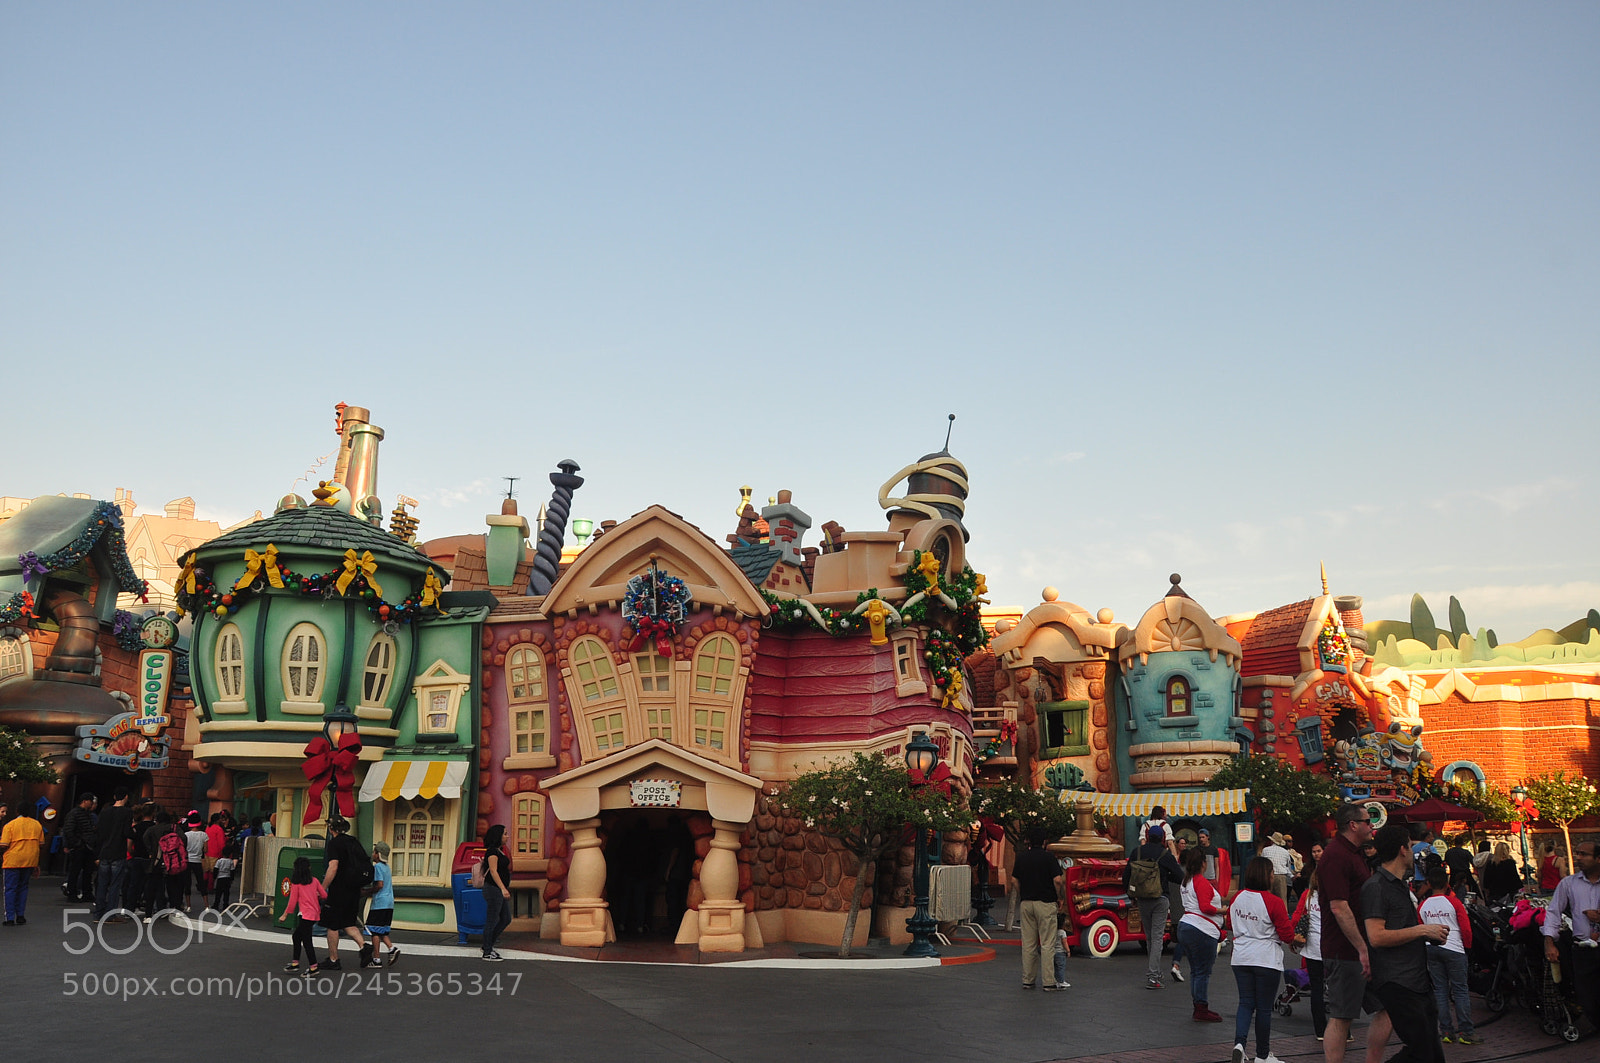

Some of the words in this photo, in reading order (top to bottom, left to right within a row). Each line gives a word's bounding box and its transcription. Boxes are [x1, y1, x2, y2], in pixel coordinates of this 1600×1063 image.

[145, 654, 165, 716] CLOCK
[109, 718, 129, 738] GAG
[136, 716, 166, 726] REPAIR
[1044, 762, 1085, 788] SAFE
